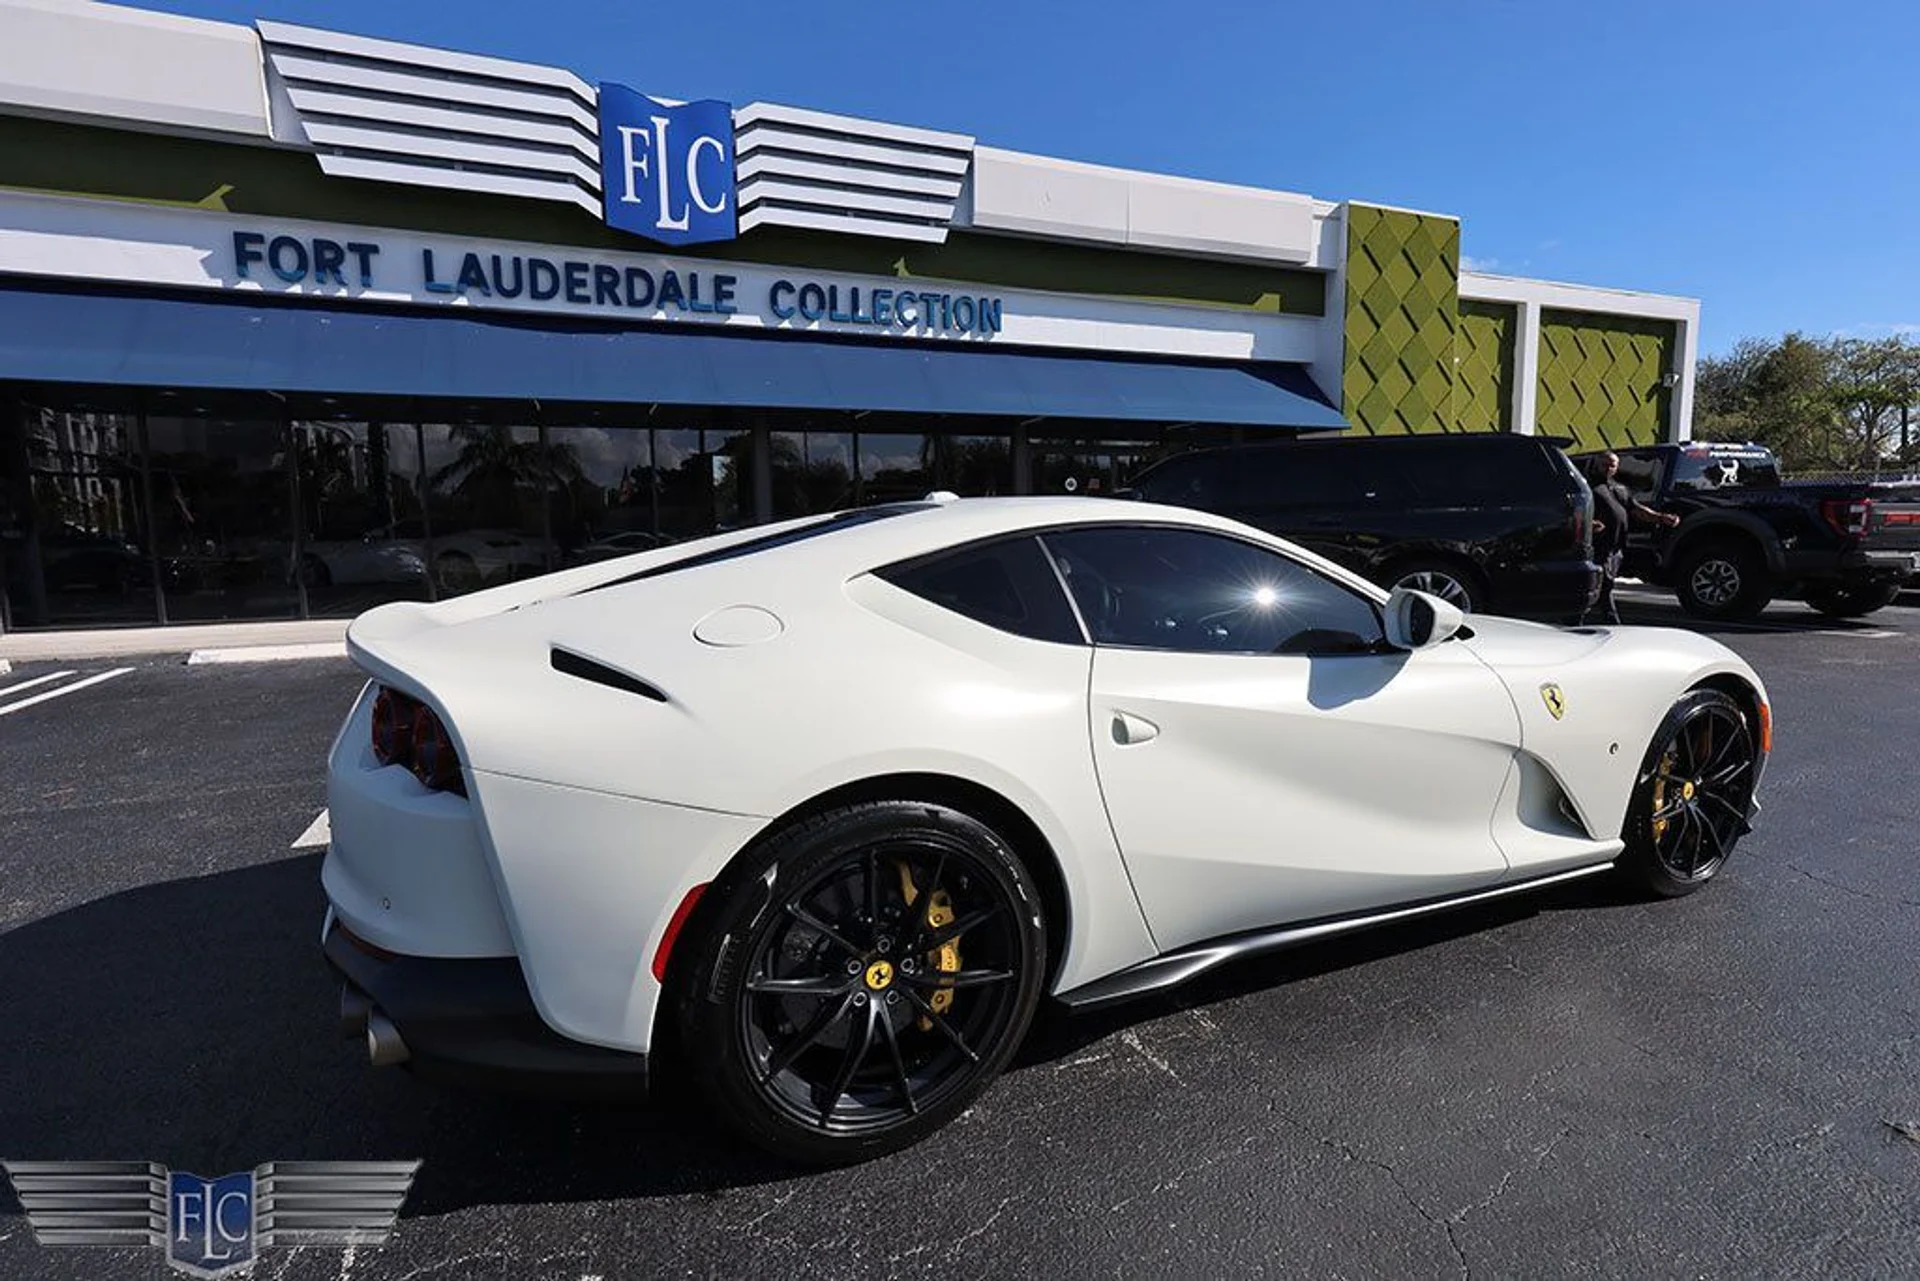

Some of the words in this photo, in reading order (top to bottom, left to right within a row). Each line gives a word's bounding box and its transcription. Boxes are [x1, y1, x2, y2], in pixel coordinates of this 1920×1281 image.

[617, 115, 726, 231] FLC
[233, 231, 379, 287] FORT
[422, 248, 738, 314] LAUDERDALE
[770, 280, 1002, 332] COLLECTION
